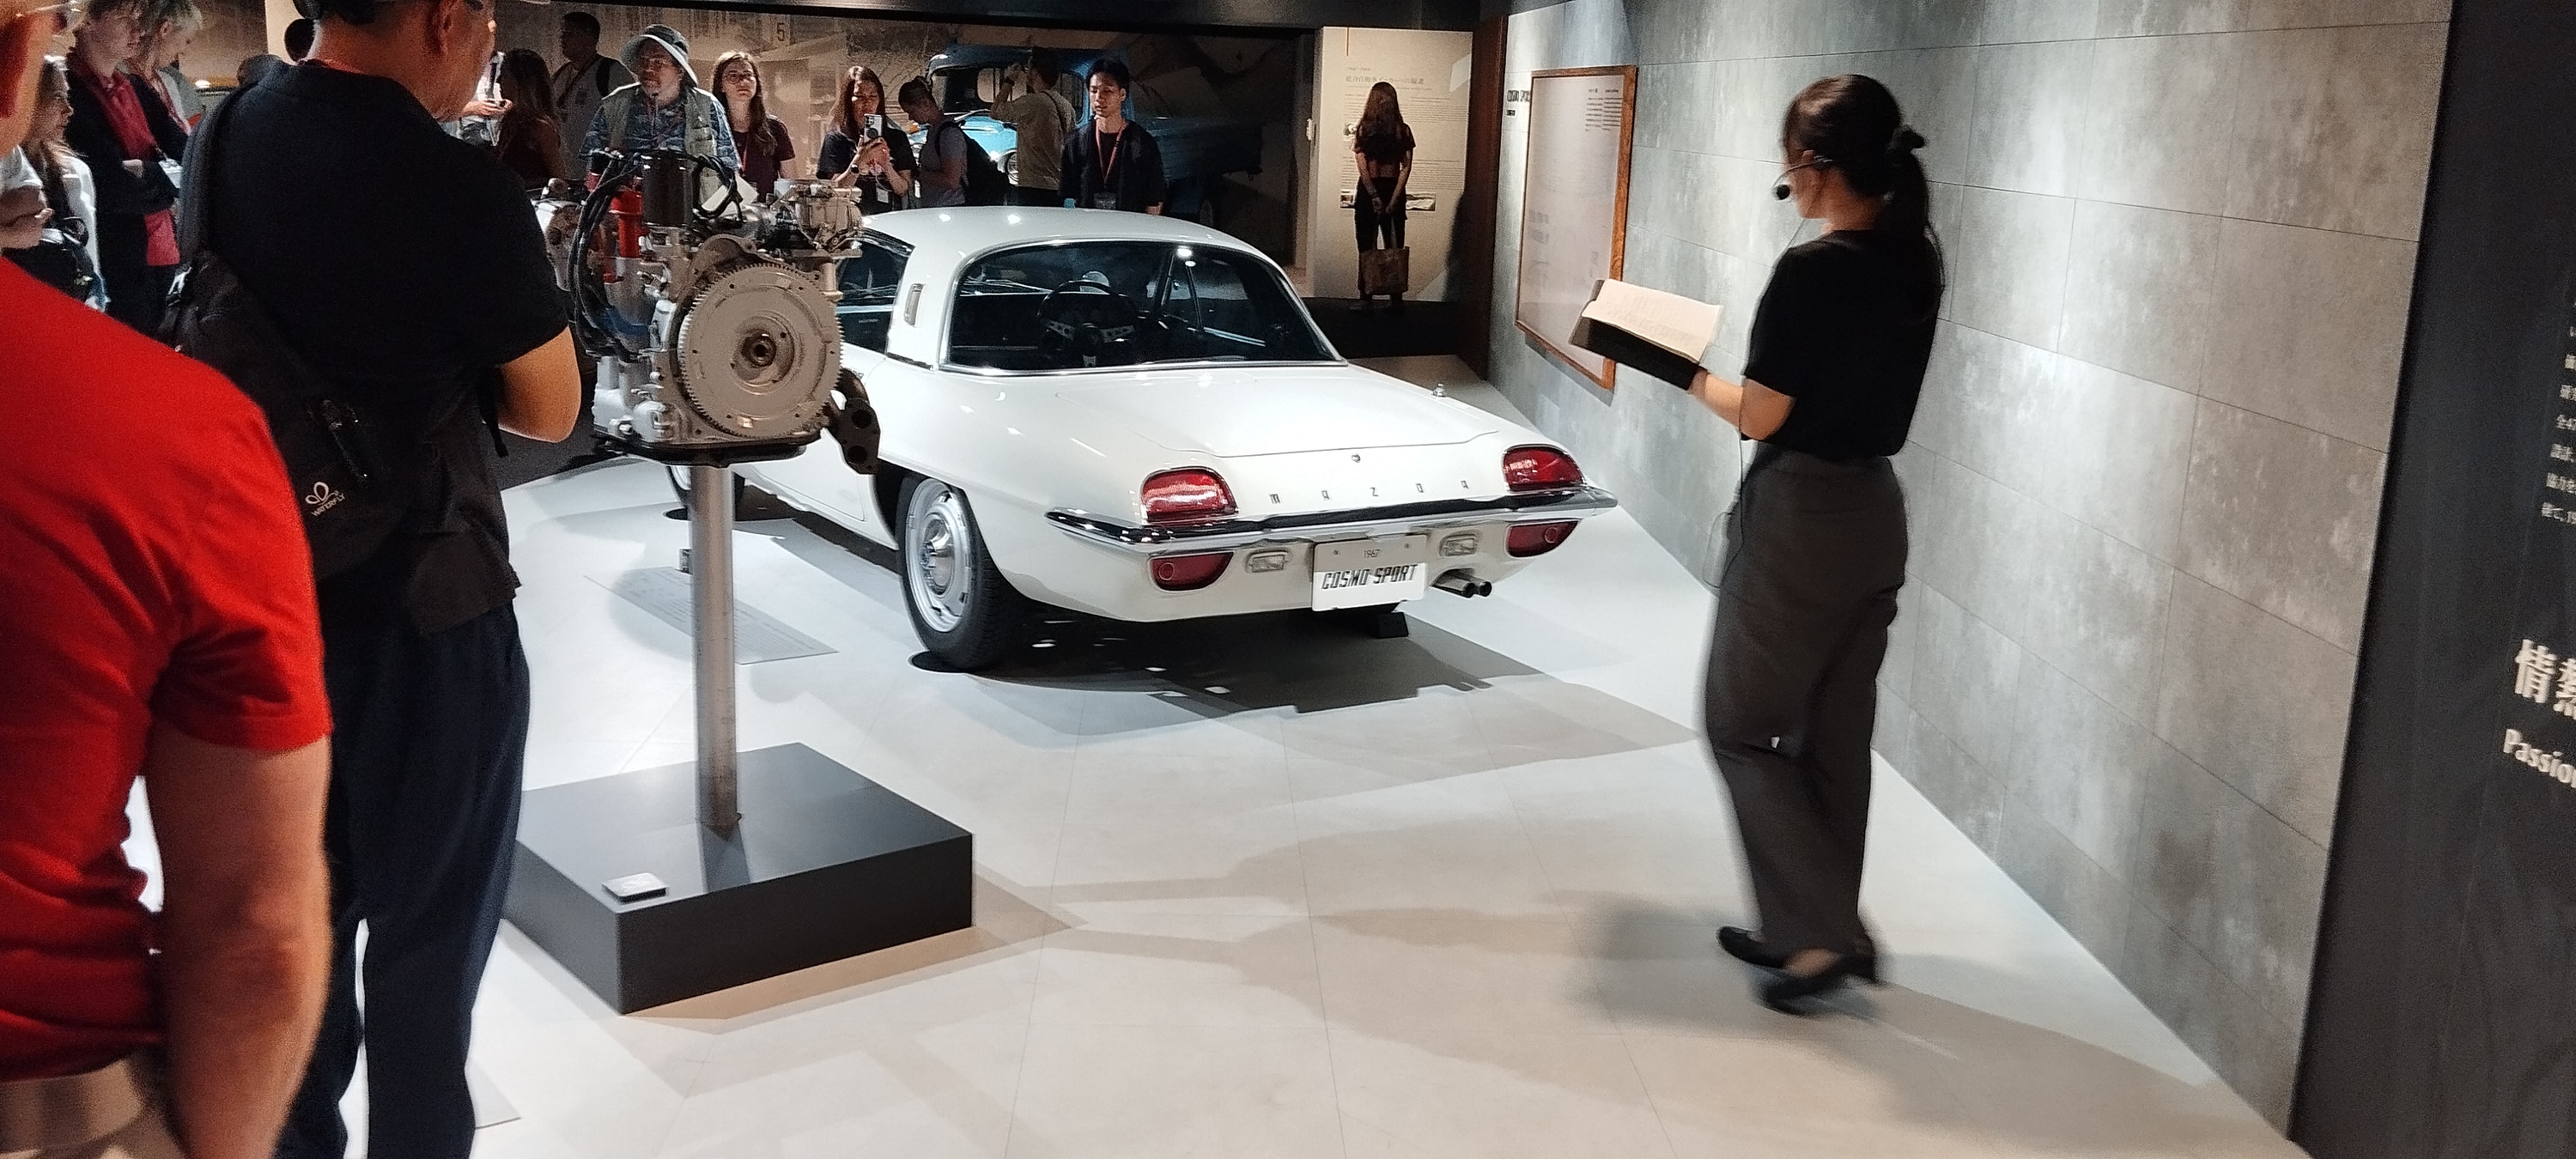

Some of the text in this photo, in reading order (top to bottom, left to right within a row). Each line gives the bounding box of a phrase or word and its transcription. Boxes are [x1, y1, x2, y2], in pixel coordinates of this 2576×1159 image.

[1364, 549, 1382, 559] 1967
[1321, 563, 1419, 590] COSMO SPORT
